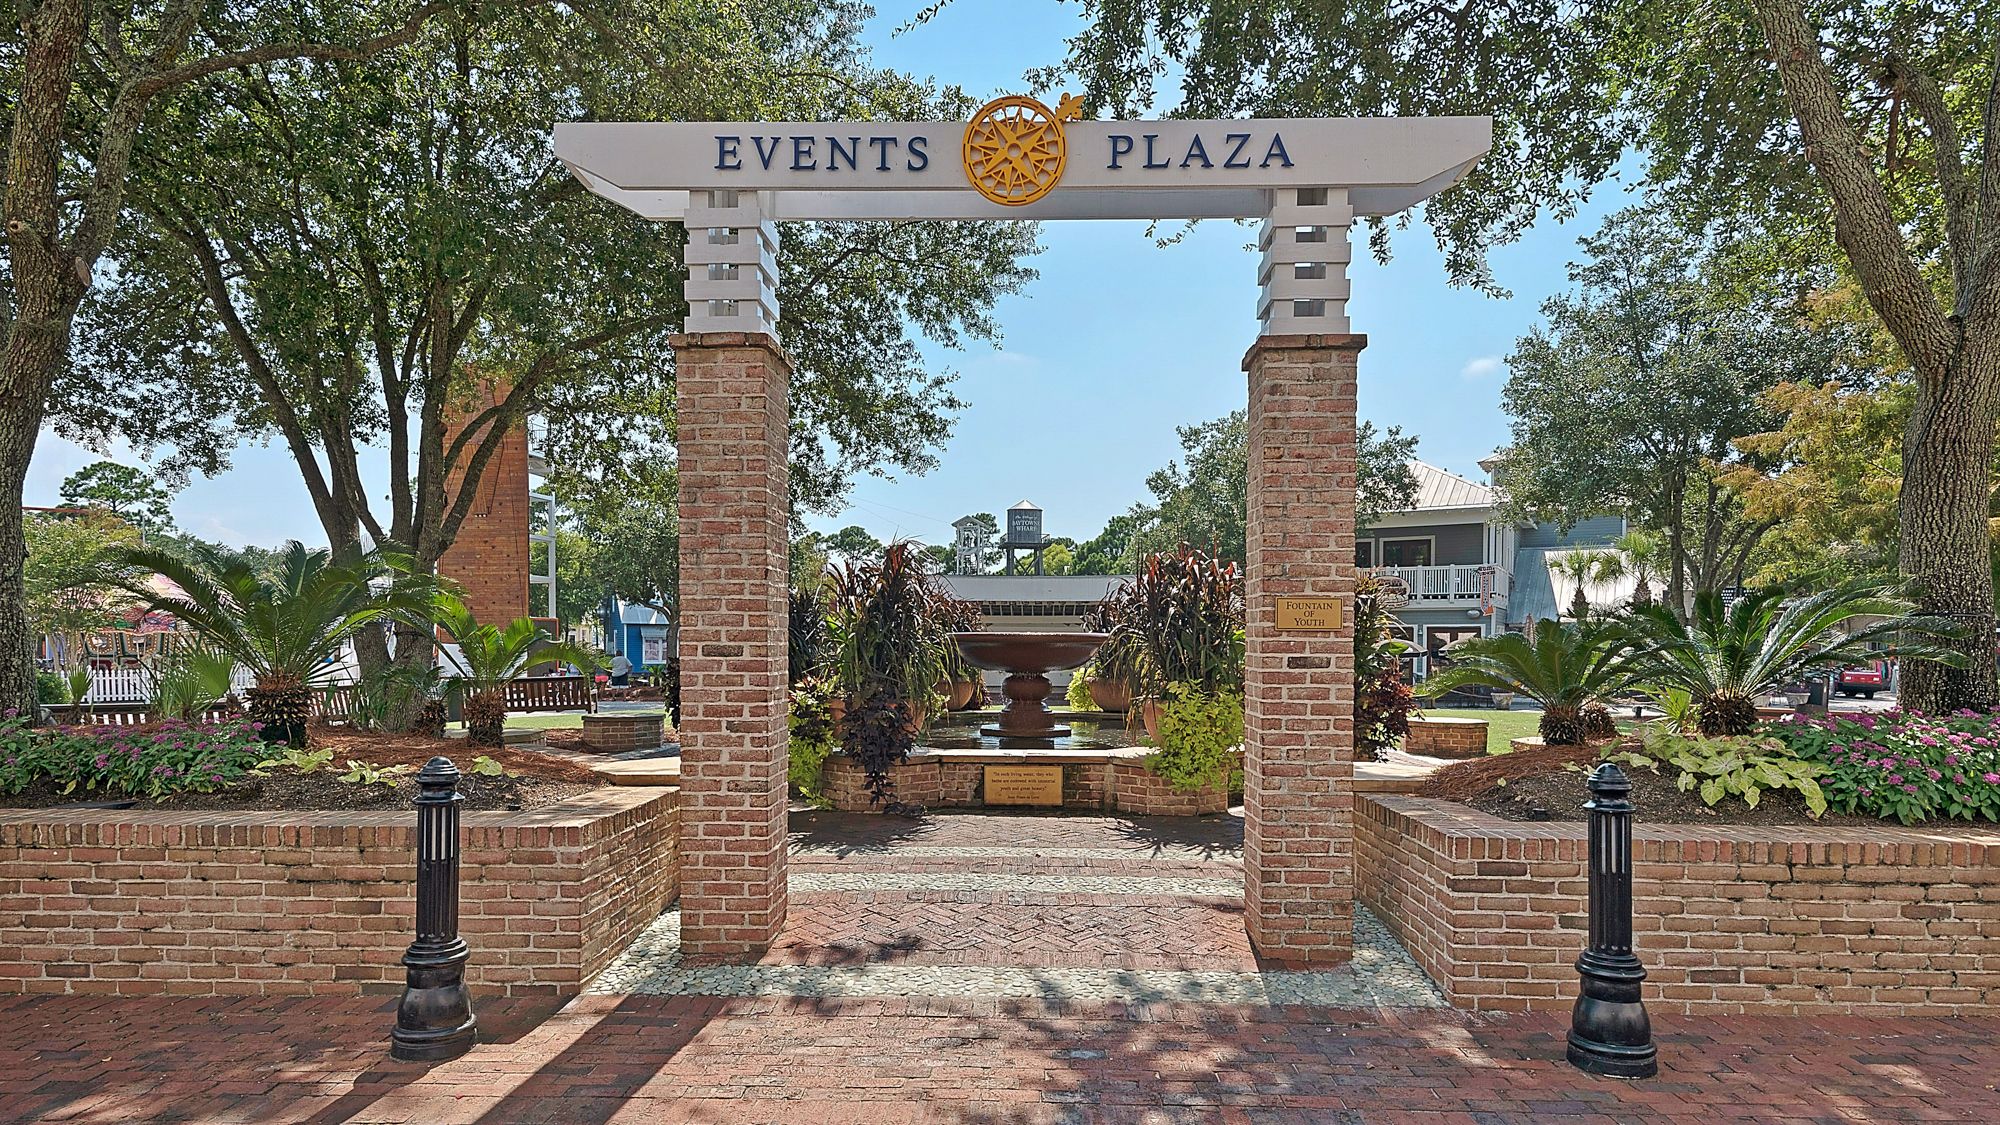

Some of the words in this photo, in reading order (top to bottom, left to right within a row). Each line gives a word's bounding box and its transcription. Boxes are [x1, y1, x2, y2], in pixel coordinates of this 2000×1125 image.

[714, 136, 928, 171] EVENTS
[1106, 132, 1295, 169] PLAZA
[1286, 601, 1333, 610] FOUNTAIN
[1303, 610, 1315, 618] OF
[1294, 617, 1325, 627] YOUTH
